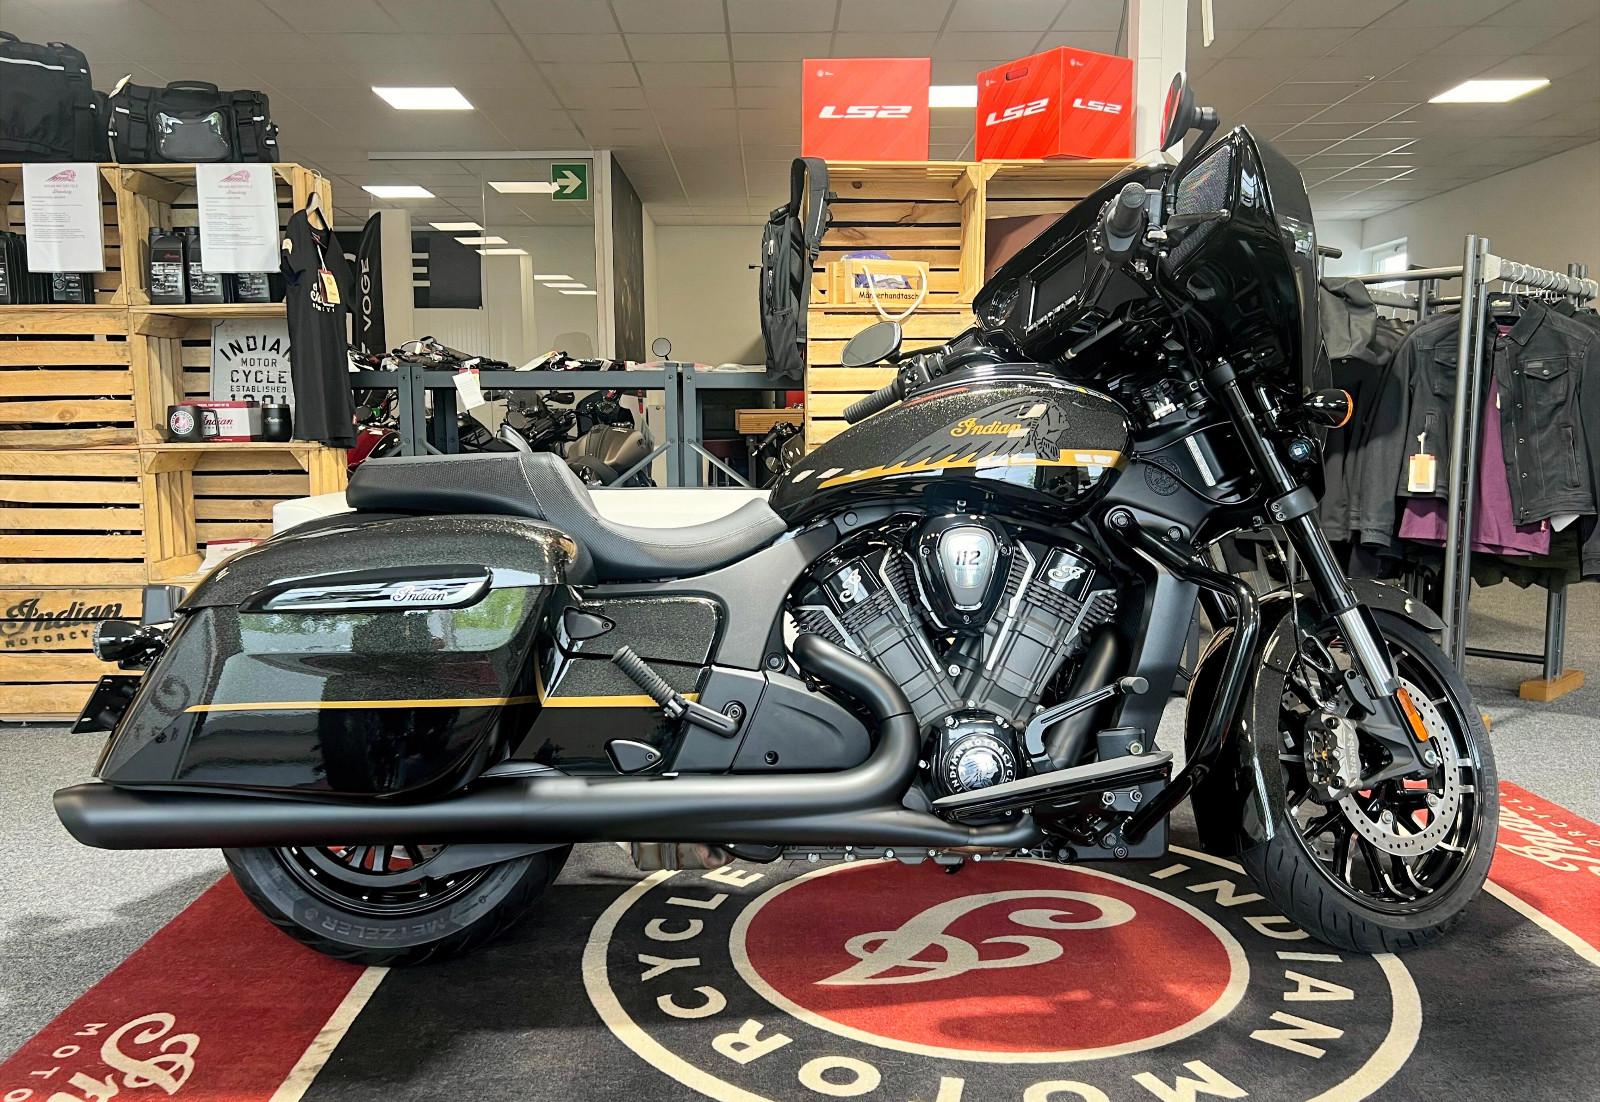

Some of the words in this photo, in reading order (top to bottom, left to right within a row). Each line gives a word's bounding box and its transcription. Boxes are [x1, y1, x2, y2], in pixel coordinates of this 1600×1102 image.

[819, 105, 912, 118] LS2
[985, 97, 1049, 127] LS2
[1073, 98, 1122, 115] LS2
[360, 257, 372, 332] VOGE
[858, 291, 919, 300] Mänerhandtasch
[241, 357, 277, 367] MOTOR
[230, 369, 288, 384] CYCLE
[230, 385, 287, 393] ESTABLISHED
[950, 417, 1021, 437] Indian
[955, 550, 981, 566] 112
[389, 585, 448, 602] Indian
[0, 598, 123, 637] Indian
[963, 736, 1014, 783] MOTORCYCL
[320, 915, 447, 941] METZELER
[1149, 863, 1355, 1059] INDIAN
